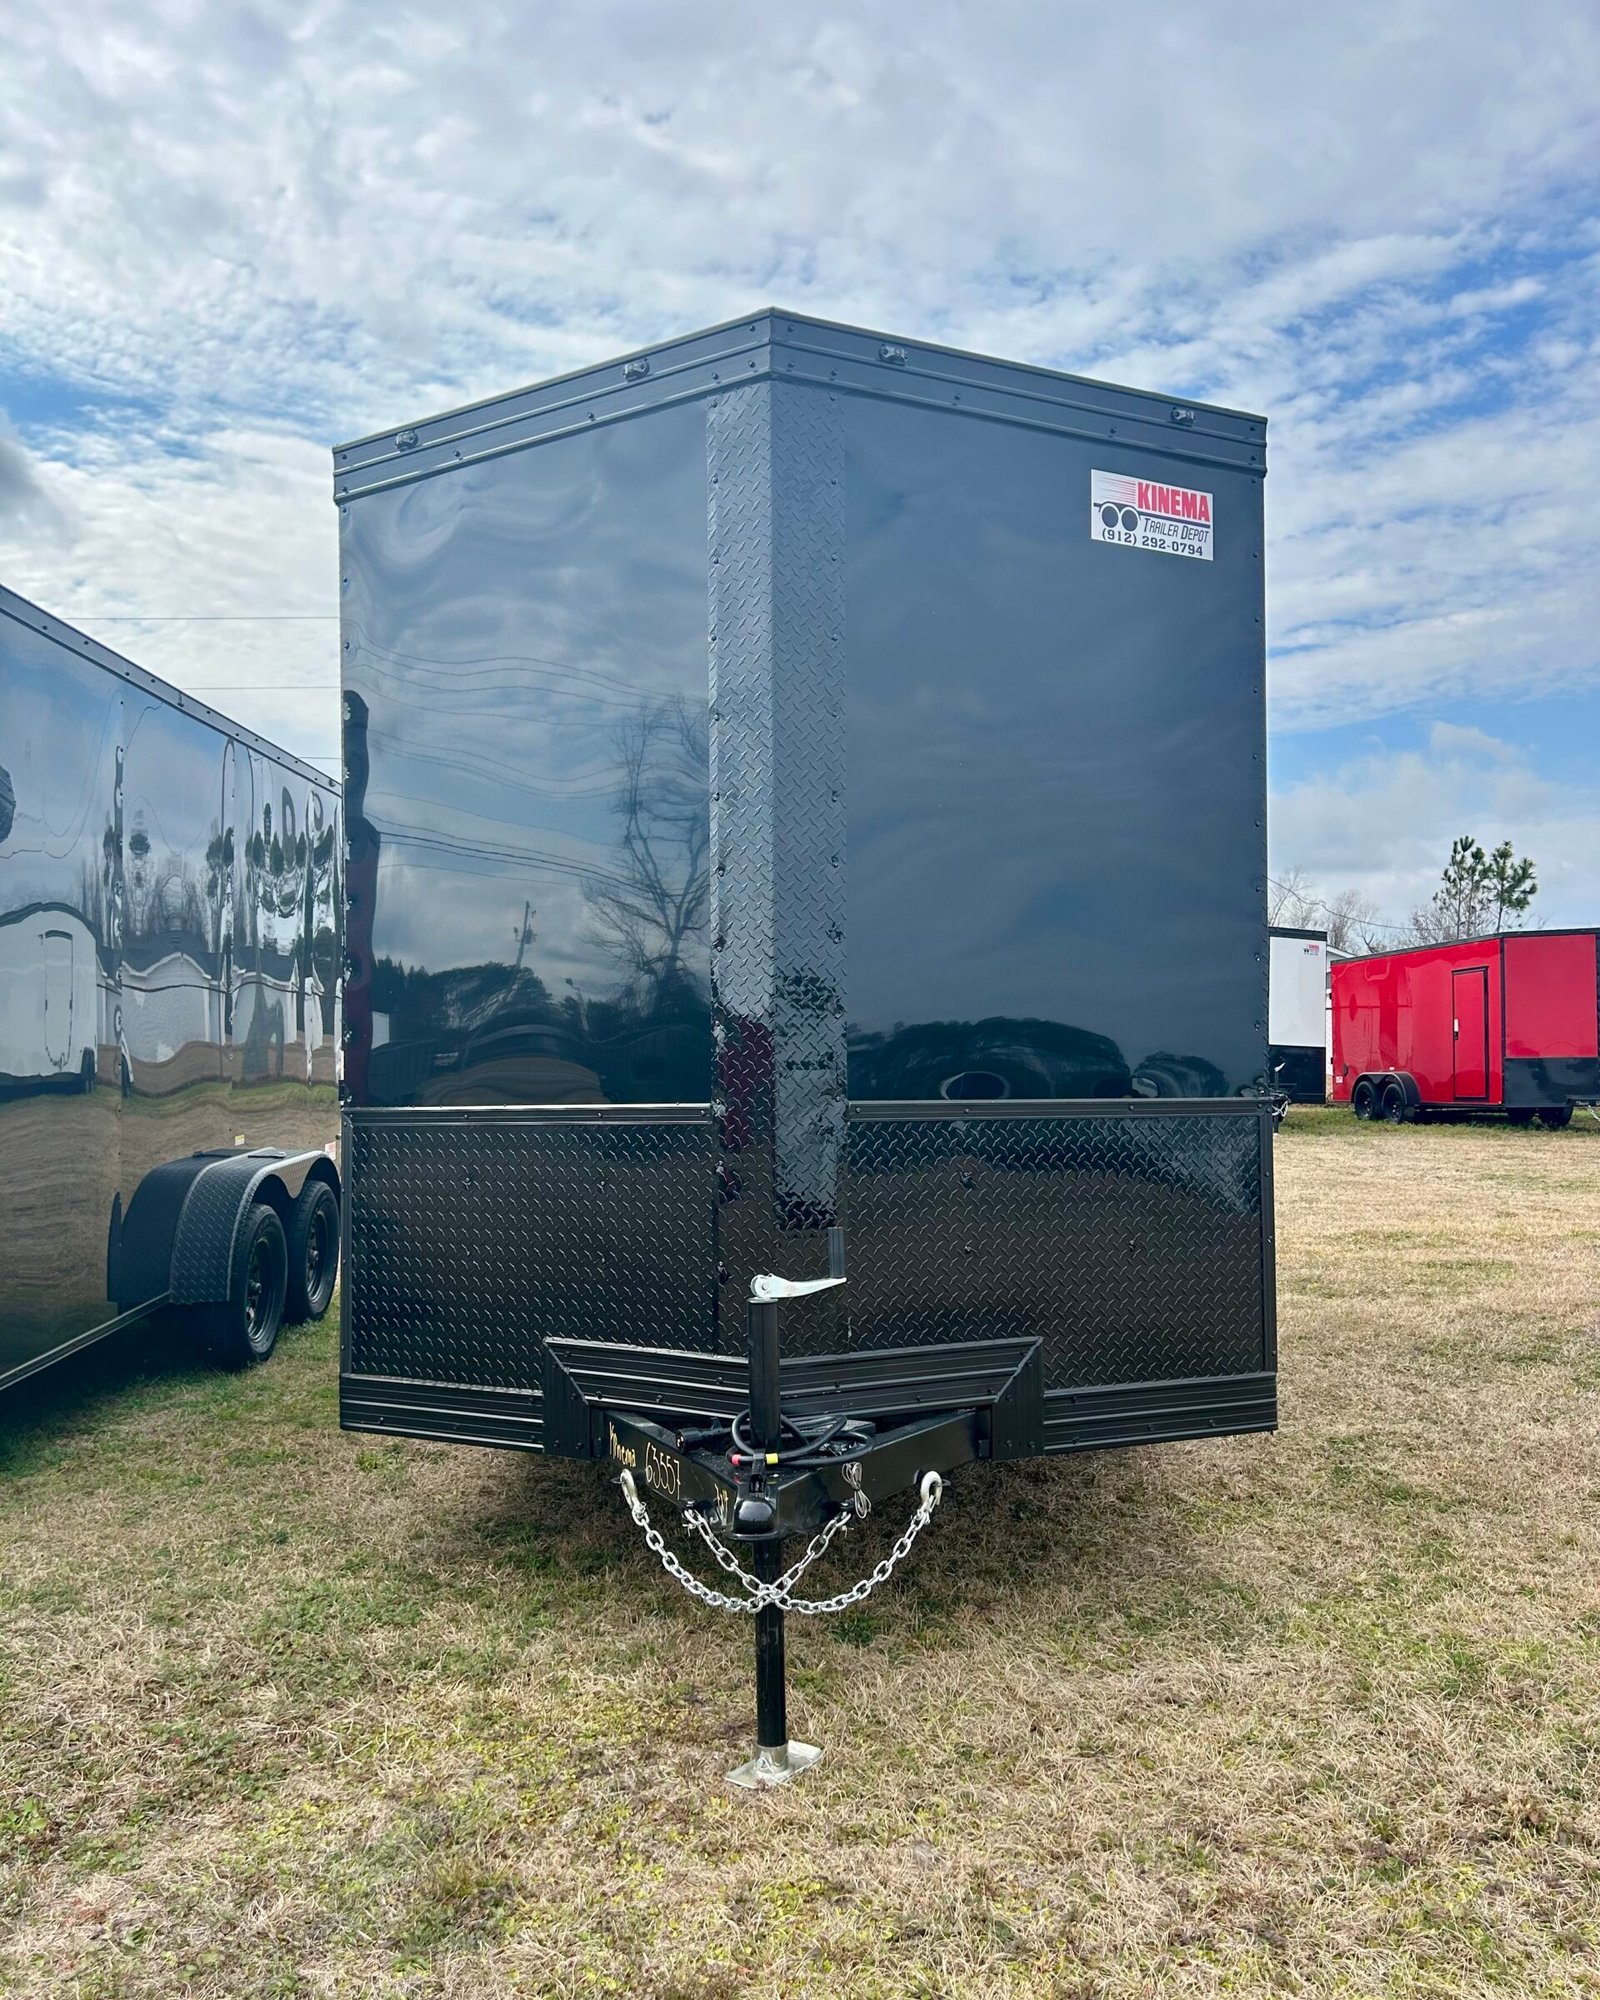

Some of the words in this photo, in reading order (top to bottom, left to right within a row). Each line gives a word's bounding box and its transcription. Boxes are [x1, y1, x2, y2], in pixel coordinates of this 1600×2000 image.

[1138, 482, 1210, 522] KINEMA
[1102, 528, 1137, 545] (912)
[1142, 536, 1203, 556] 292-0794
[1143, 517, 1179, 537] TRAILER
[1181, 525, 1209, 543] DEPOT
[645, 1442, 680, 1500] 63557
